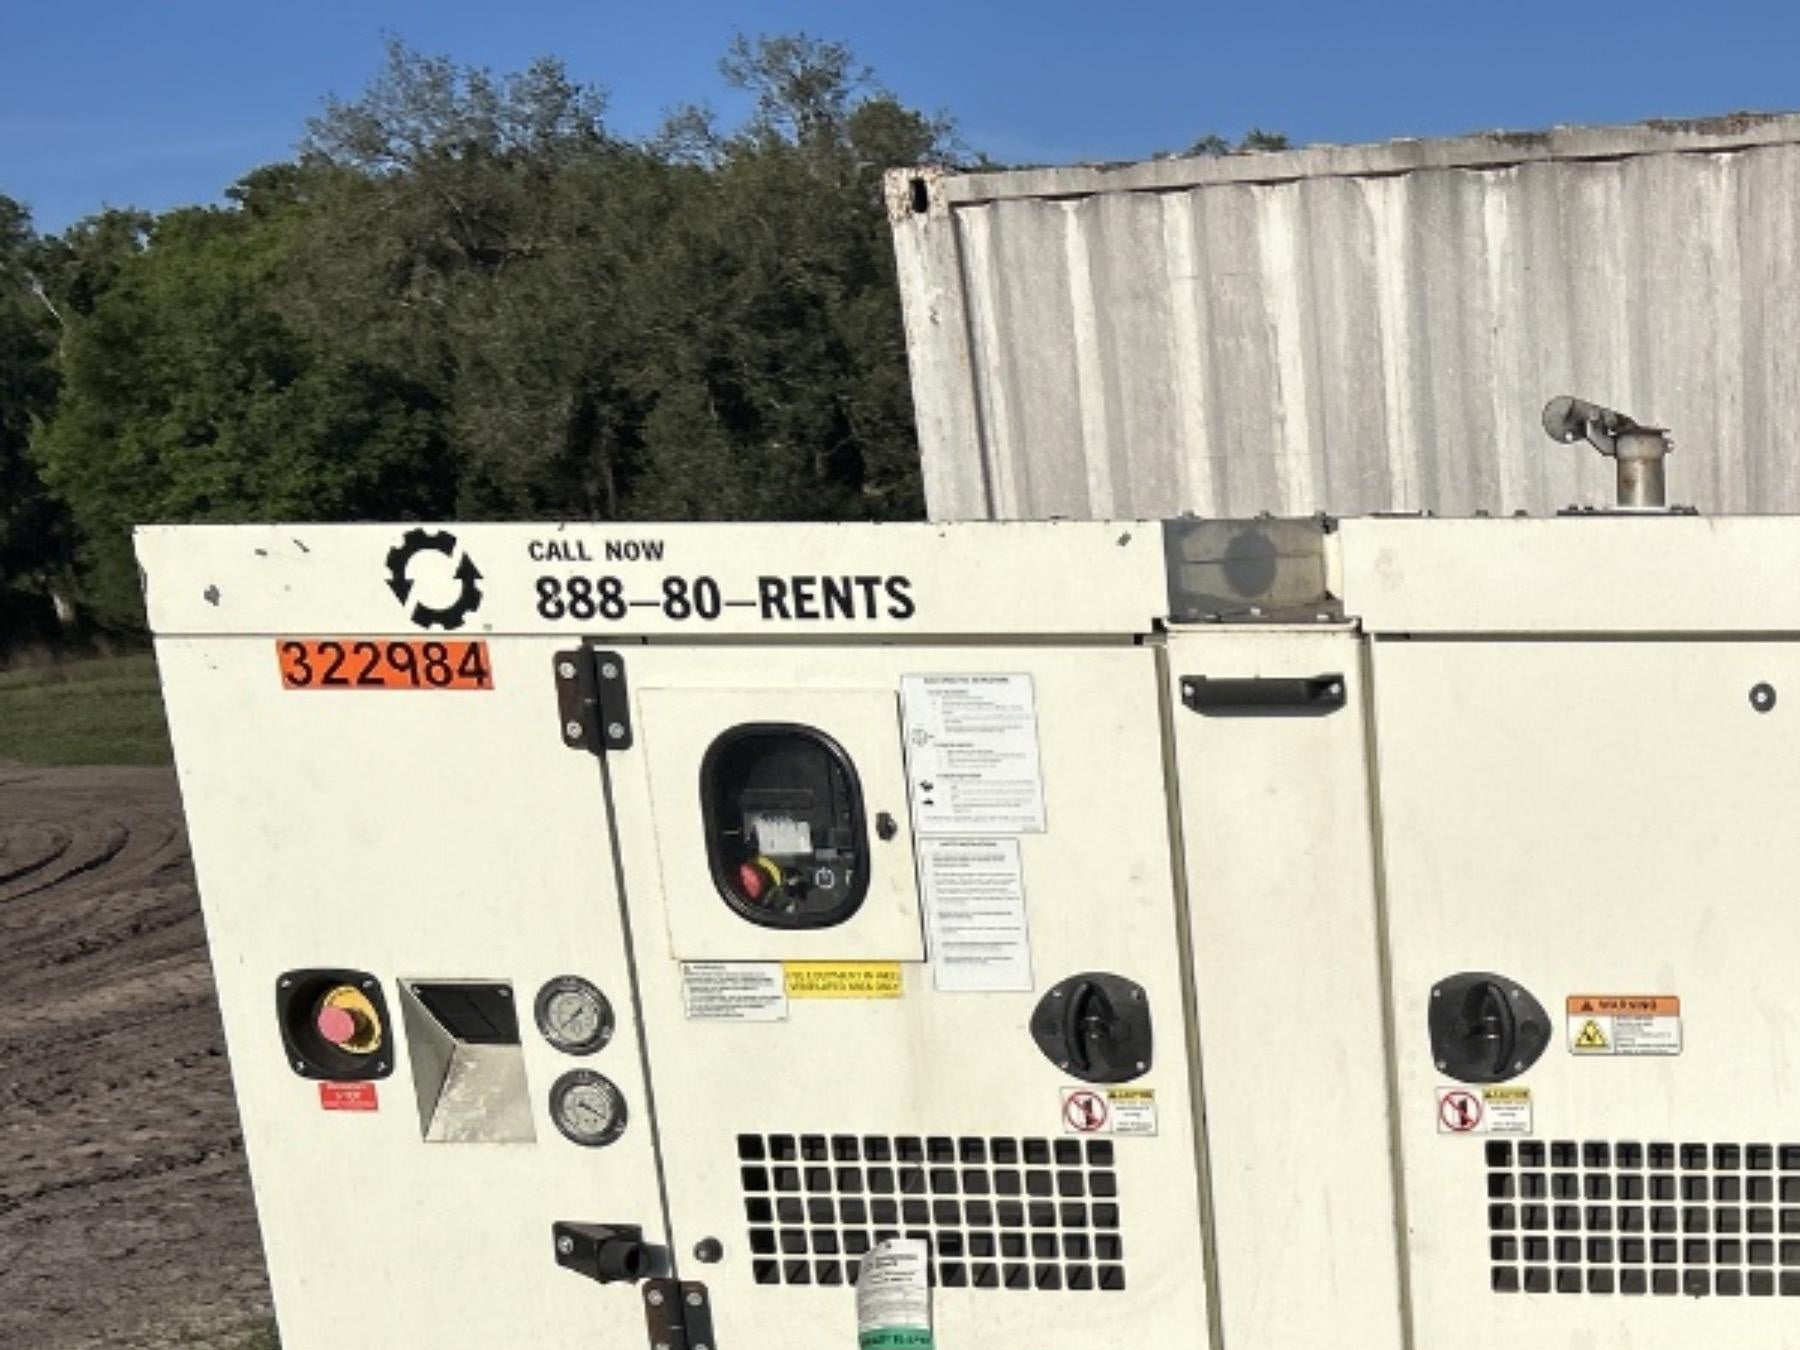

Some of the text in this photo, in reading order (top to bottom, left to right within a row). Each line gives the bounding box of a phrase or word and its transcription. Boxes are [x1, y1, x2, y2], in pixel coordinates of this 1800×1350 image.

[527, 540, 664, 562] CALL NOW
[535, 575, 916, 621] 888-80-RENTS
[282, 641, 488, 687] 322984
